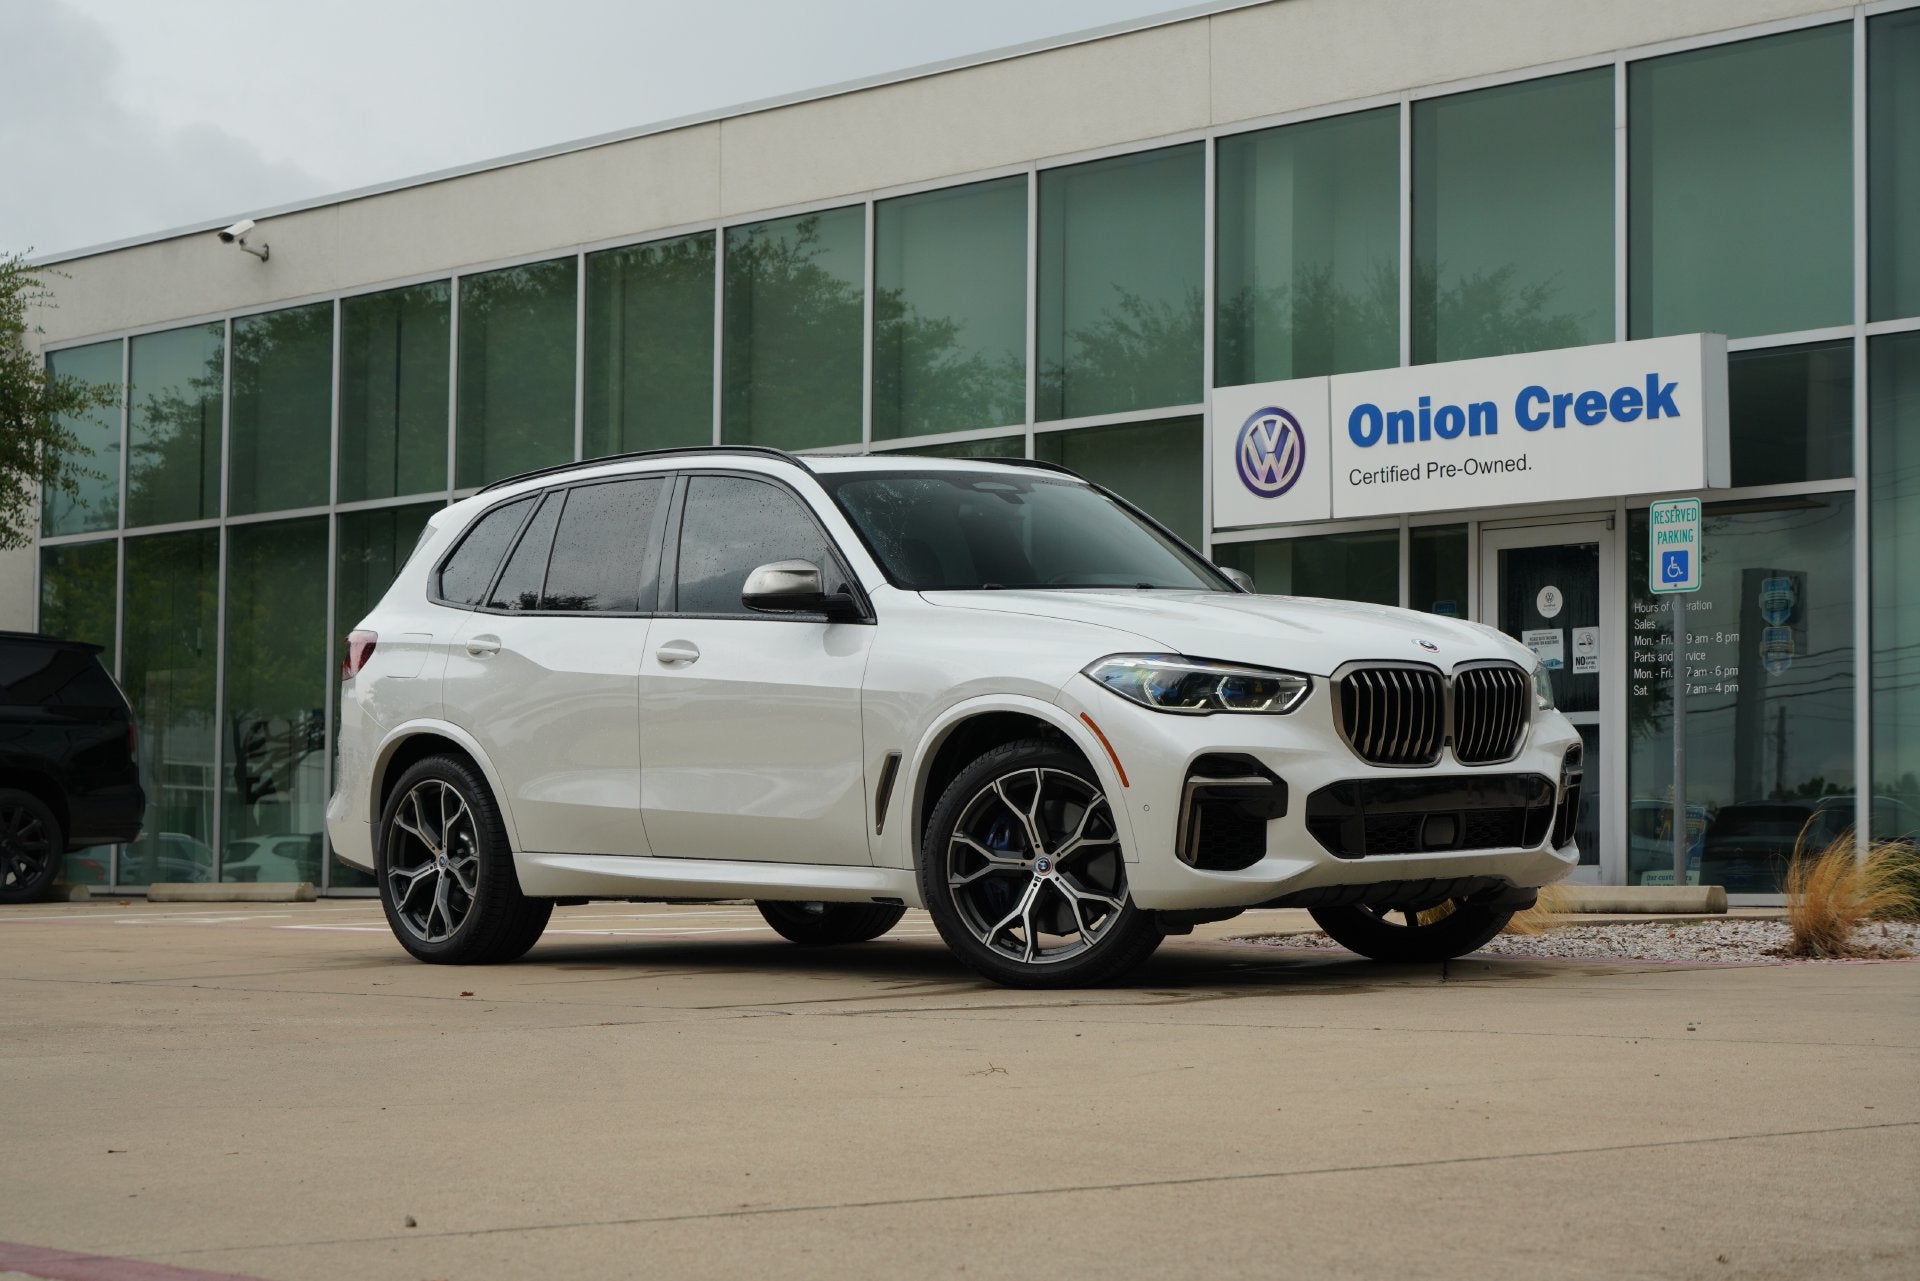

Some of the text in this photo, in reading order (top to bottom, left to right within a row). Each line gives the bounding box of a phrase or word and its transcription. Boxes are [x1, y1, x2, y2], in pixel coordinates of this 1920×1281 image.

[1348, 373, 1681, 448] Onion Creek
[1240, 412, 1301, 493] VW
[1349, 453, 1532, 486] Certified Pre-Owned.
[1654, 507, 1697, 524] RESERVED
[1657, 528, 1694, 545] PARKING
[1634, 600, 1712, 613] Hours of ration
[1634, 619, 1656, 630] Sales
[1634, 635, 1654, 646] Mon.
[1686, 633, 1693, 645] 9
[1695, 634, 1708, 644] am
[1716, 632, 1722, 643] 8
[1725, 633, 1739, 645] pm
[1575, 656, 1586, 666] NO
[1634, 651, 1706, 663] Parts and rvice
[1633, 668, 1653, 679] Mon.
[1660, 667, 1673, 678] Fri.
[1686, 666, 1692, 677] 7
[1694, 668, 1708, 677] am
[1715, 666, 1721, 676] 6
[1724, 667, 1739, 678] pm
[1686, 683, 1692, 694] 7
[1693, 685, 1707, 694] am
[1715, 683, 1721, 692] 4
[1724, 684, 1739, 694] pm
